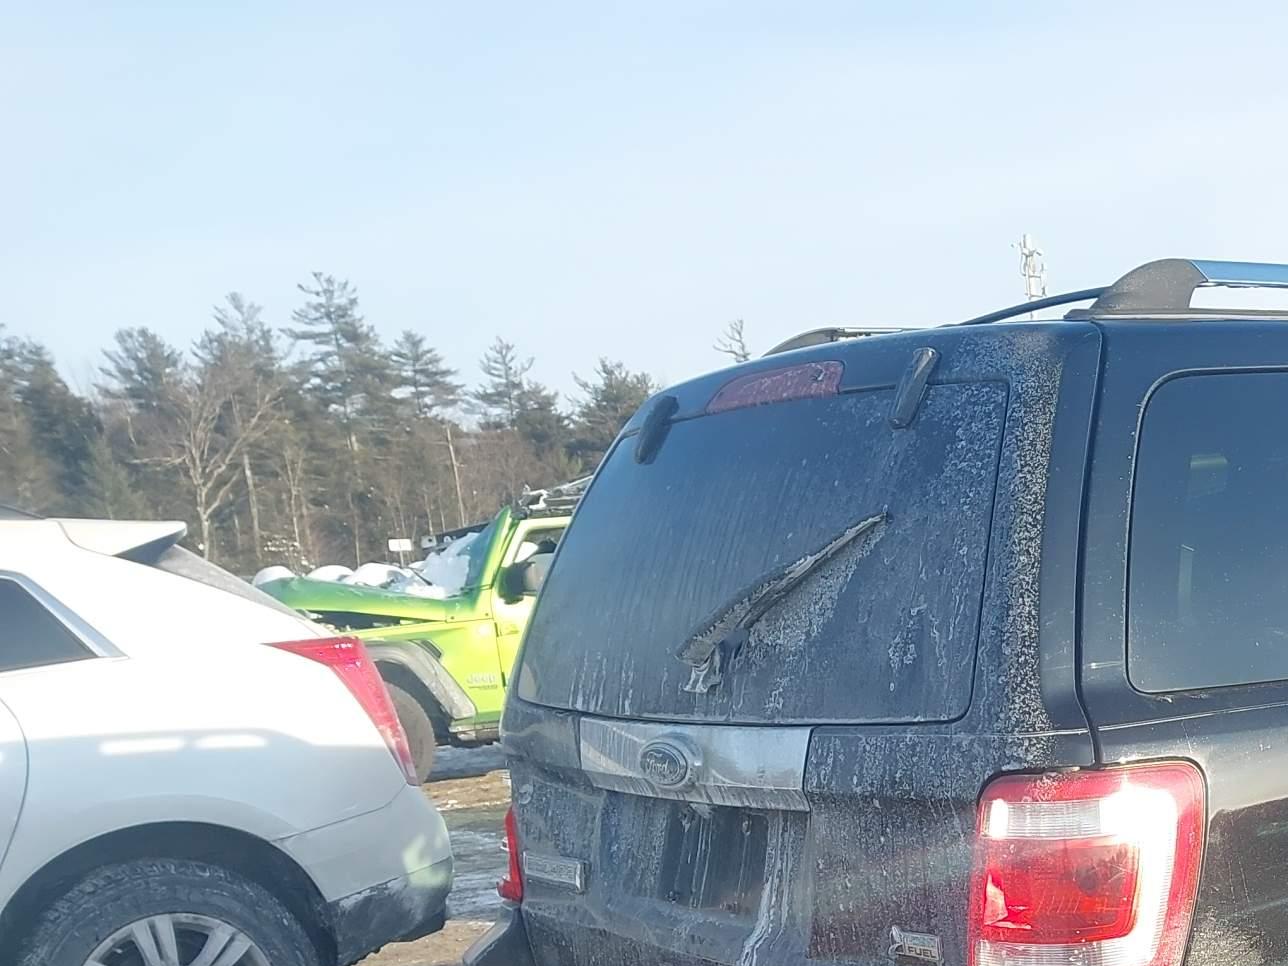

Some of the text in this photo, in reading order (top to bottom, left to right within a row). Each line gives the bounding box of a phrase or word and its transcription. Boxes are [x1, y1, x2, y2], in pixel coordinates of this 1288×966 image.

[466, 672, 496, 685] Jeep
[645, 751, 671, 774] Ford
[908, 946, 937, 959] FUEL
